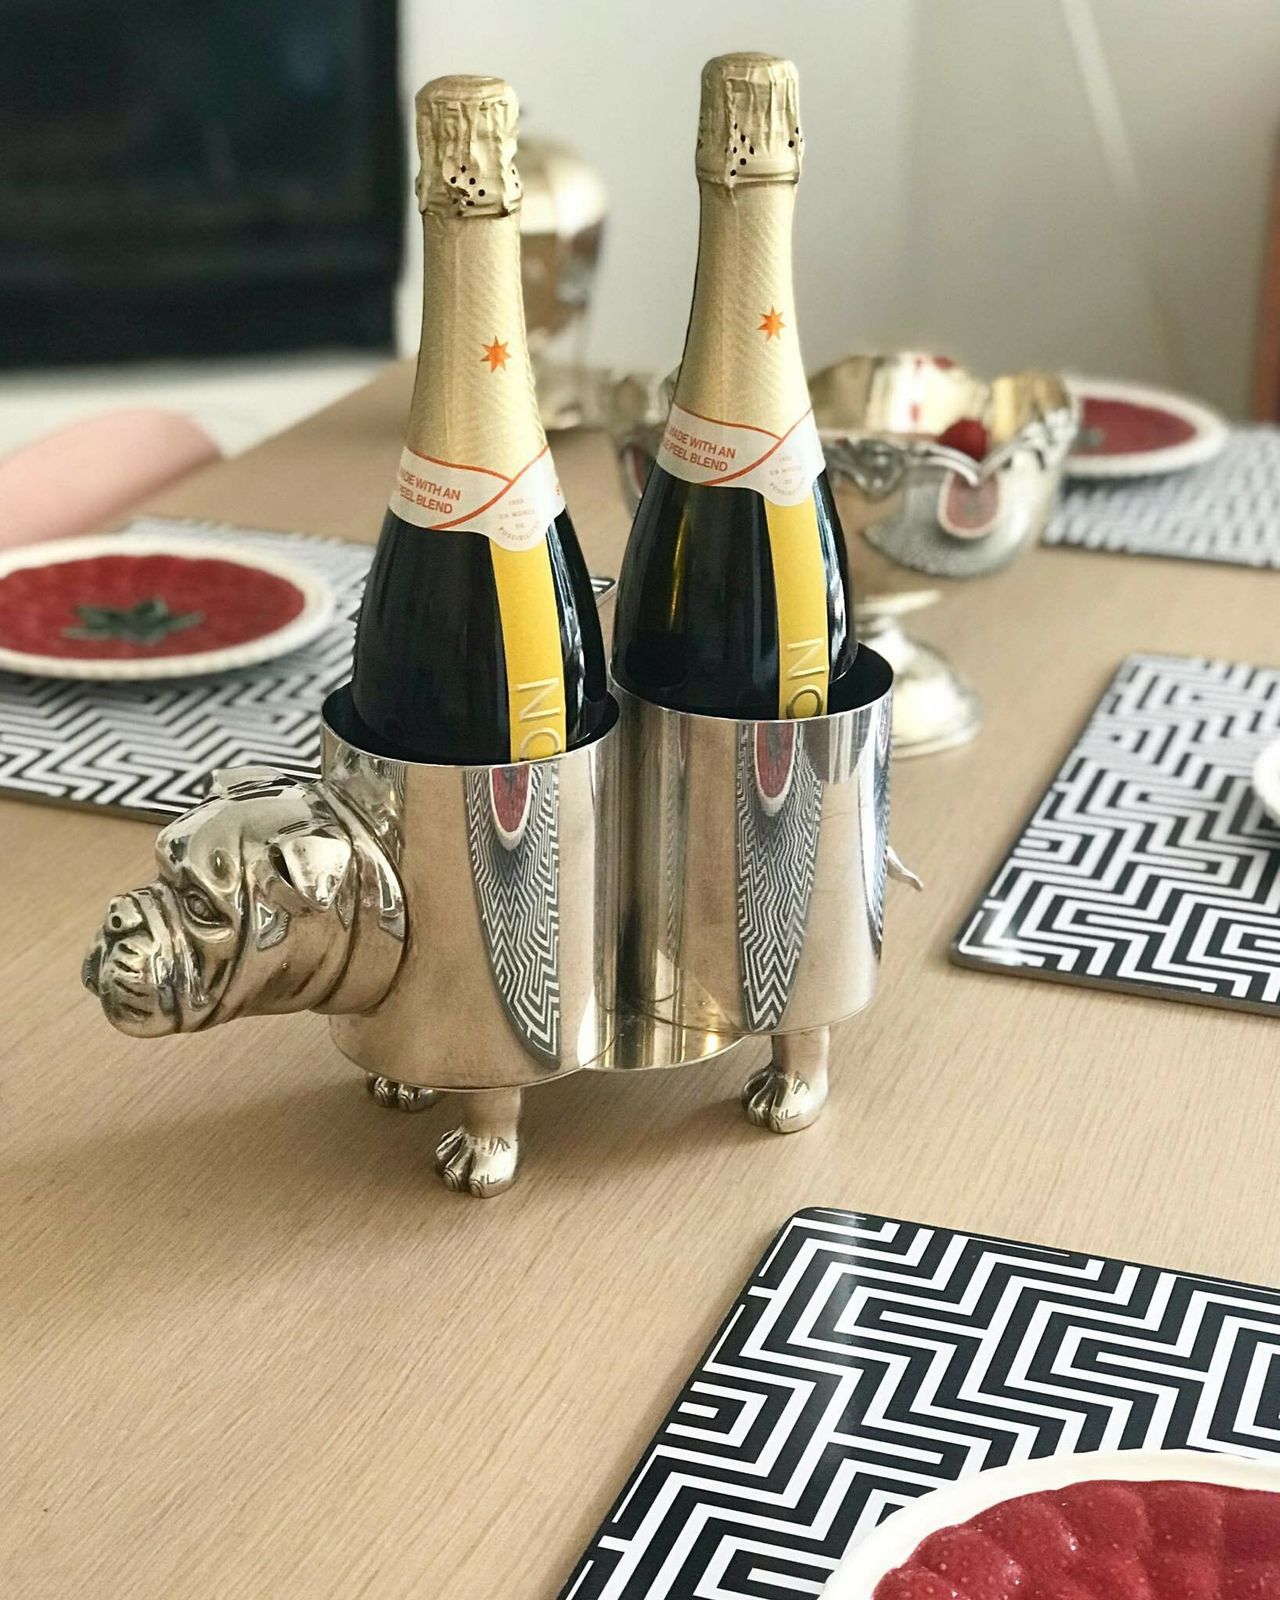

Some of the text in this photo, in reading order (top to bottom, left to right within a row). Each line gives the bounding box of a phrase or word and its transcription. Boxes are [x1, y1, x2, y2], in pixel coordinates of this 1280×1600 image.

[689, 436, 717, 455] WITH
[718, 446, 737, 459] AN
[689, 452, 728, 472] BLEND
[415, 477, 442, 496] WITH
[443, 488, 461, 501] AN
[416, 494, 453, 514] BLEND
